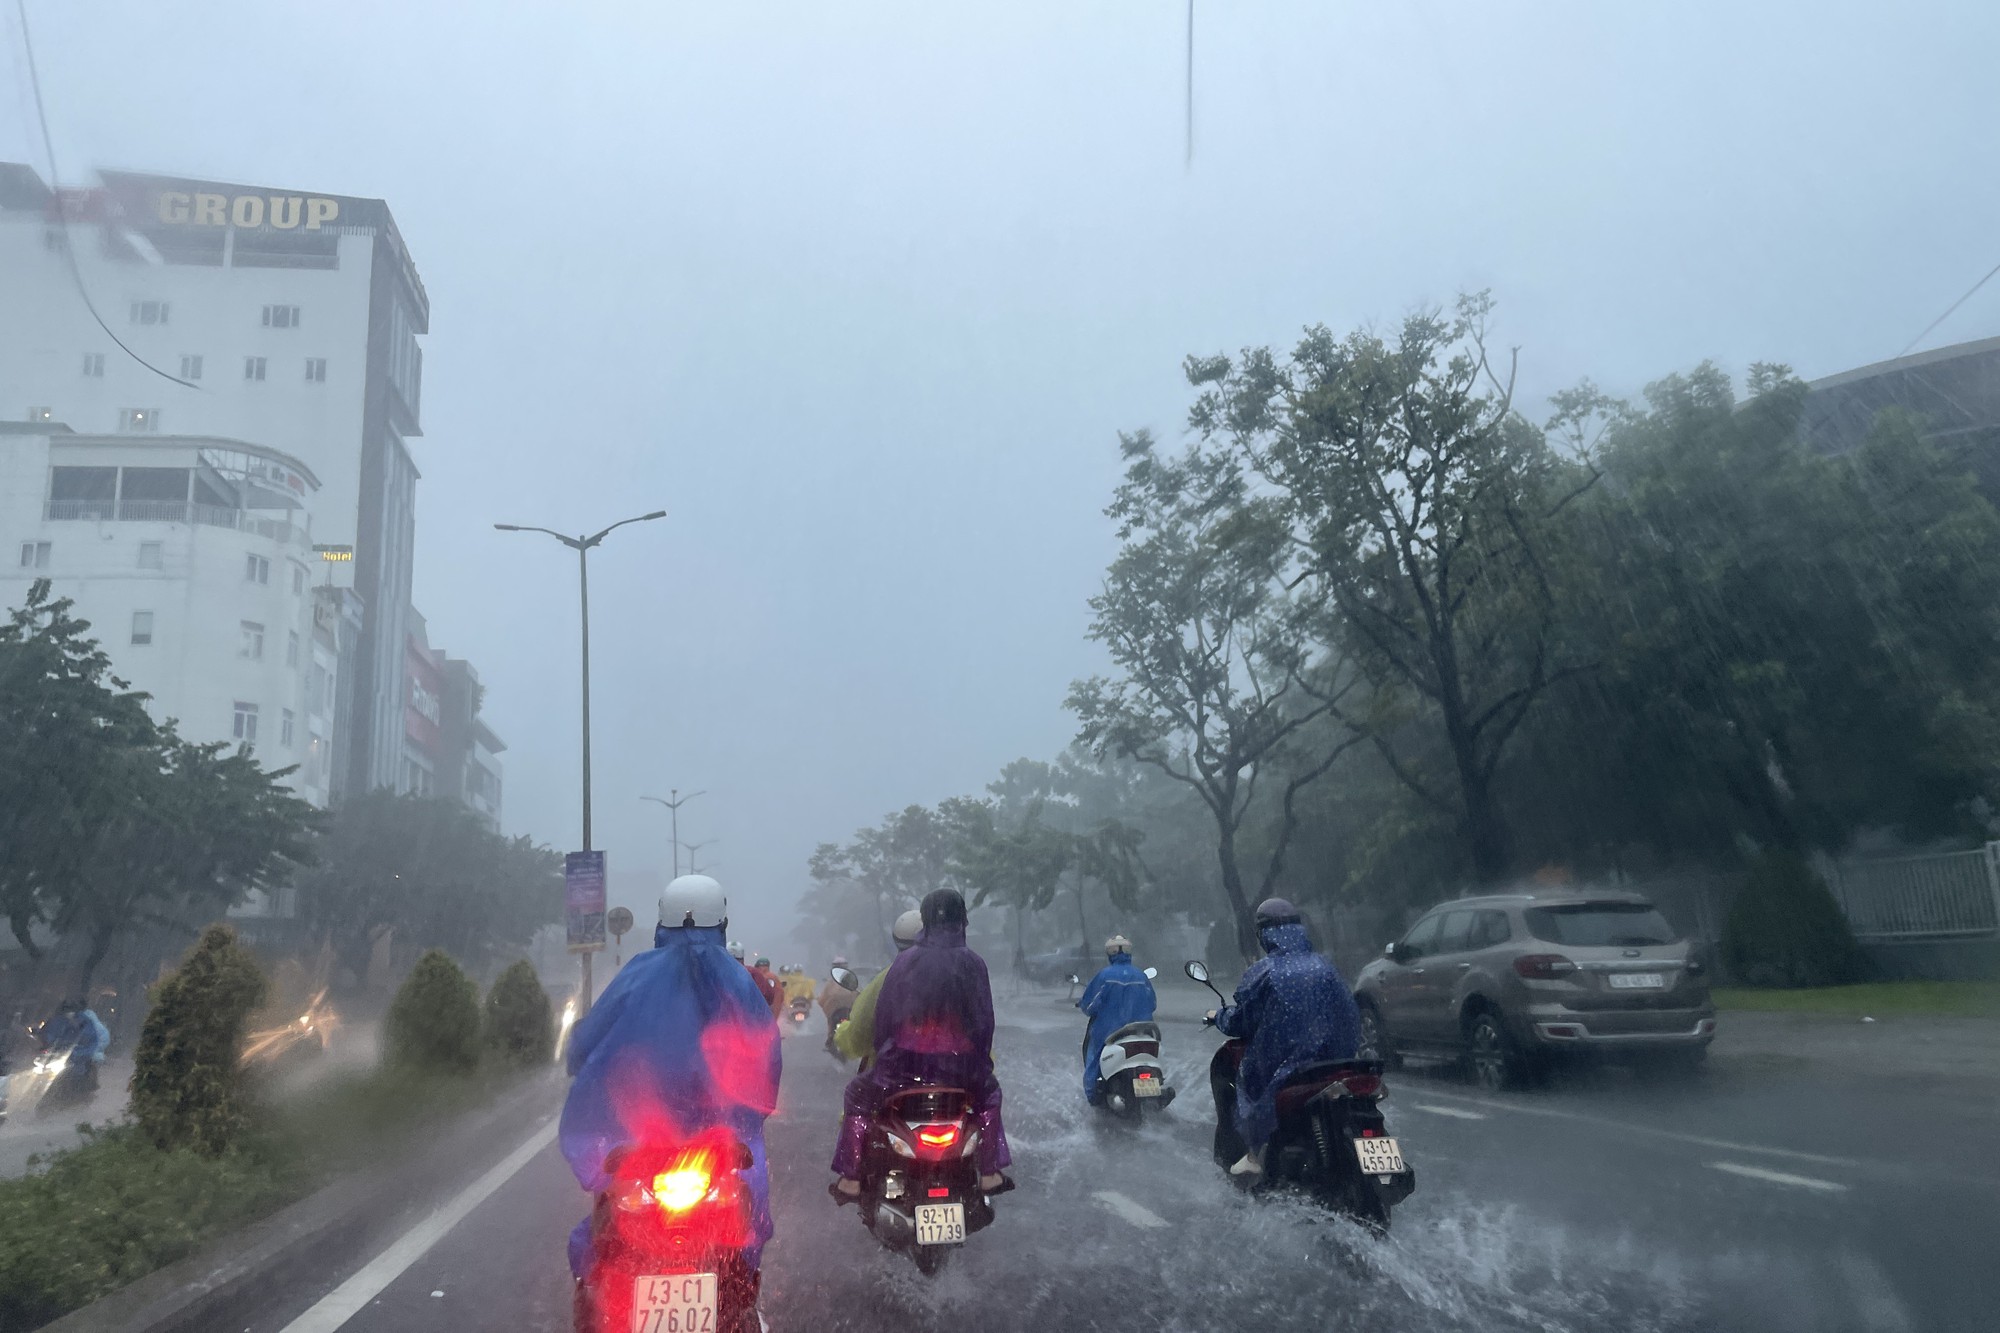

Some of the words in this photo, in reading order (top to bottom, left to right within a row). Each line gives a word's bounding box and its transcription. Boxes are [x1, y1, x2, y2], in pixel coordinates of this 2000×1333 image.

[157, 191, 340, 230] GROUP
[322, 551, 352, 561] Hotel
[1362, 1139, 1394, 1155] 43-C1
[922, 1207, 956, 1224] 92-Y1
[919, 1224, 962, 1242] 117.39
[647, 1279, 703, 1306] 43-C1
[638, 1306, 712, 1333] 776.02
